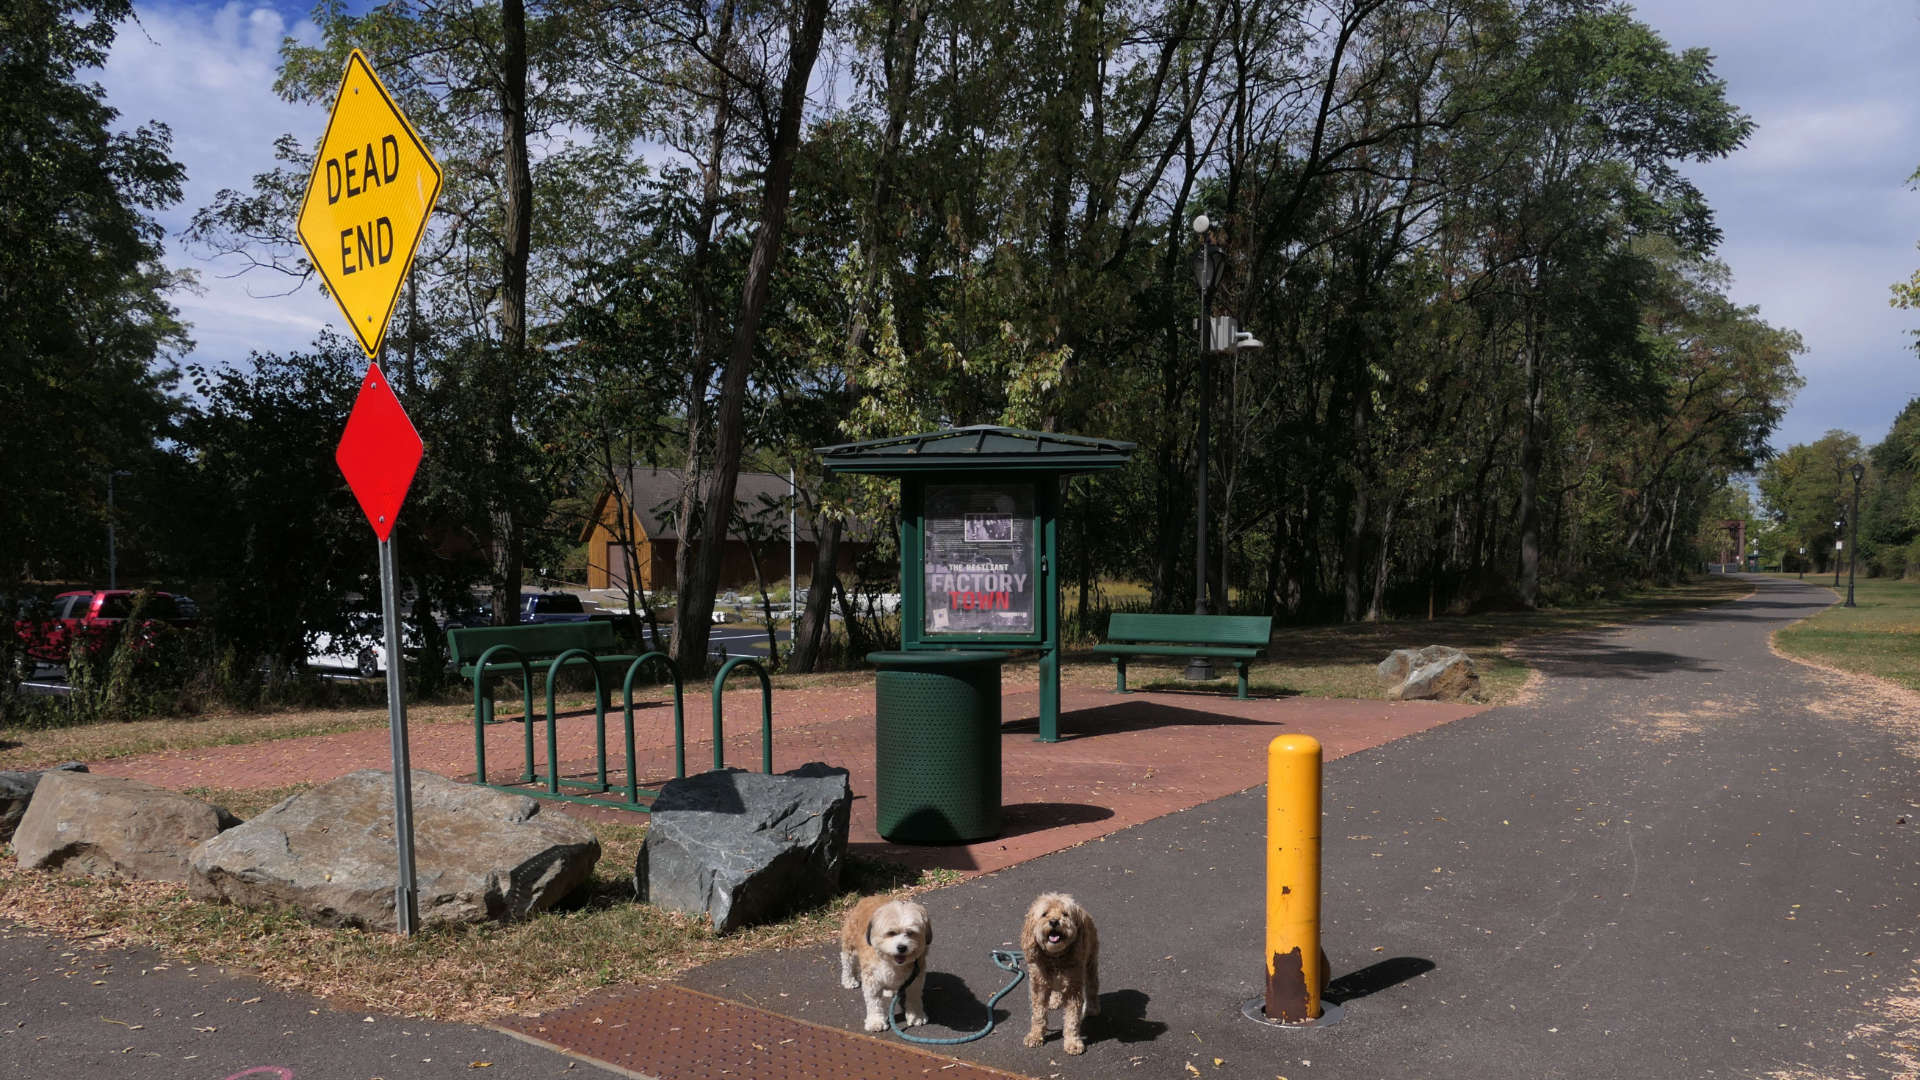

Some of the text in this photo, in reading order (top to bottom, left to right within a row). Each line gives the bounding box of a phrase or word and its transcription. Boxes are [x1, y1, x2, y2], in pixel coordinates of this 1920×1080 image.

[326, 134, 399, 206] DEAD
[340, 216, 394, 276] END
[931, 573, 1028, 592] FACTORY
[949, 591, 1010, 610] TOWN
